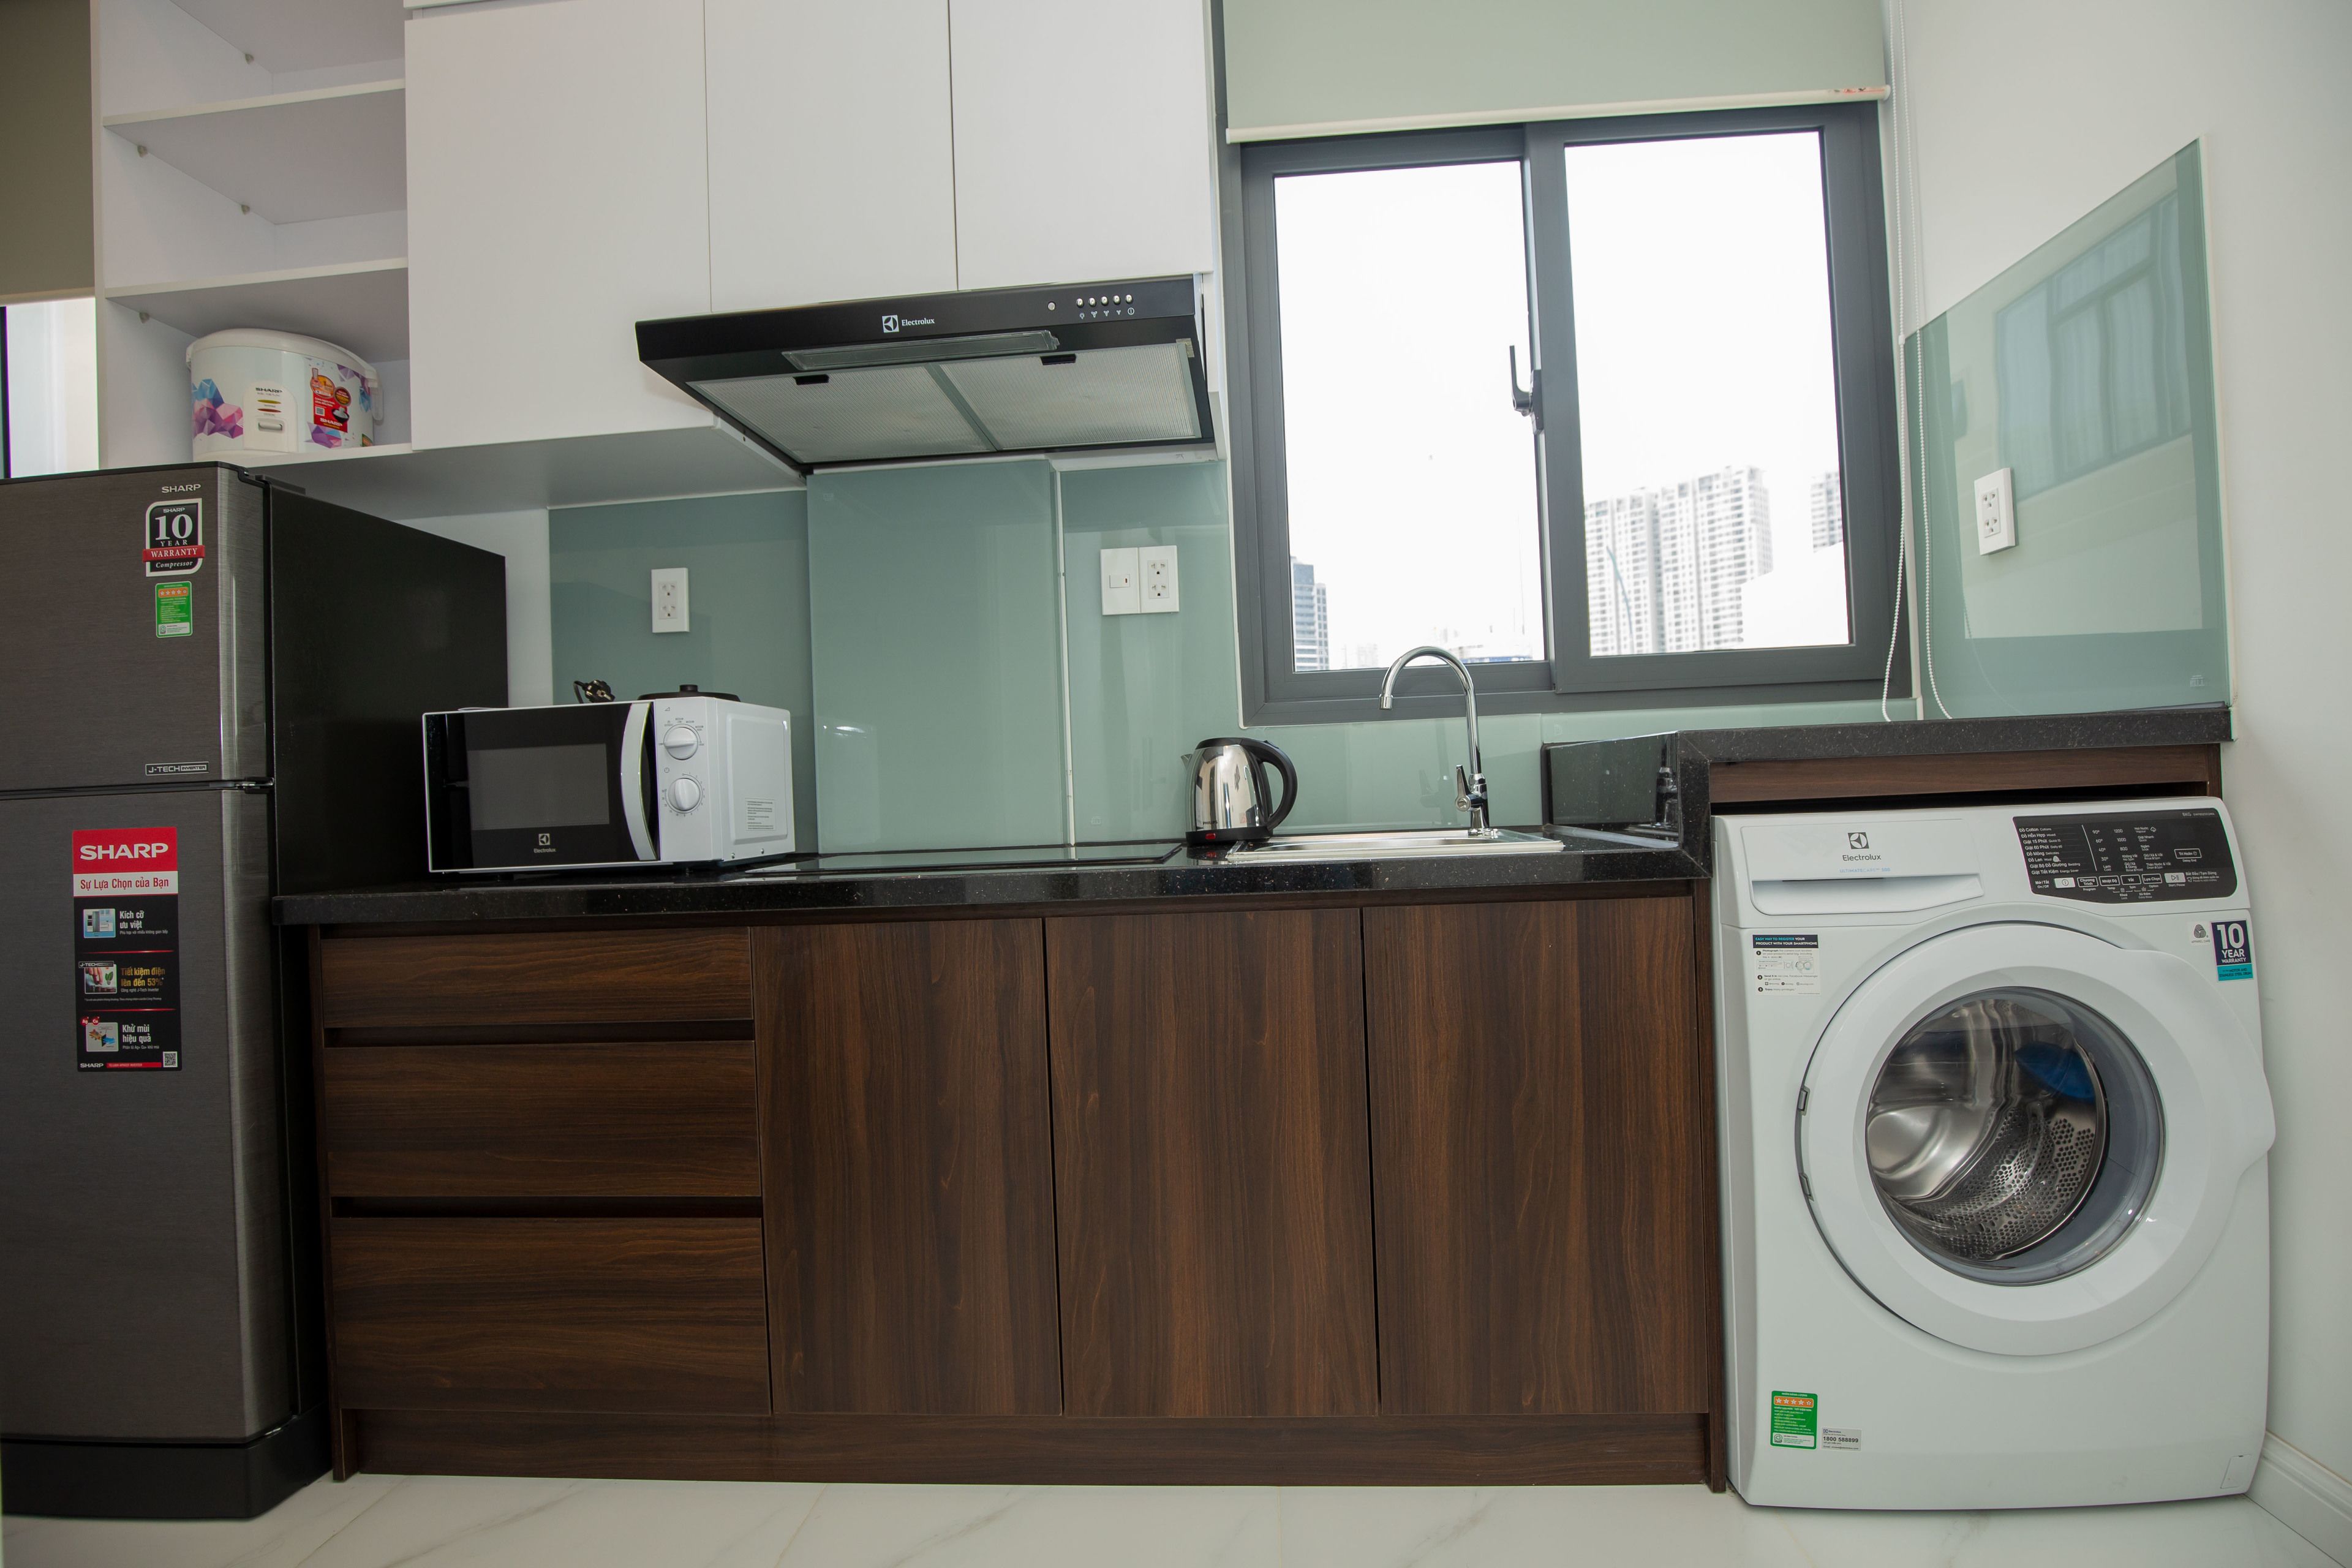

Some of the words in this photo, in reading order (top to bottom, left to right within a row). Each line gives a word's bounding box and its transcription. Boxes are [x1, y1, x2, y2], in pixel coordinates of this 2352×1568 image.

[902, 317, 935, 326] Electrolux
[162, 484, 201, 493] SHARP
[155, 514, 193, 540] 10
[151, 548, 198, 558] WARRANTY
[80, 843, 168, 861] SHARP
[80, 879, 91, 891] Sự
[94, 879, 108, 891] Lựa
[112, 878, 132, 890] Chọn
[135, 876, 149, 888] của
[154, 877, 168, 889] Bạn
[119, 910, 134, 919] Kích
[136, 910, 145, 919] cỡ
[130, 920, 142, 930] việt
[2217, 922, 2244, 949] 10
[2222, 948, 2245, 959] YEAR
[121, 967, 133, 975] Tiết
[134, 967, 150, 976] kiệm
[151, 967, 165, 976] điện
[133, 977, 145, 986] đến
[123, 1023, 136, 1033] Khử
[137, 1024, 150, 1033] mùi
[123, 1034, 137, 1044] hiệu
[139, 1033, 151, 1044] quả
